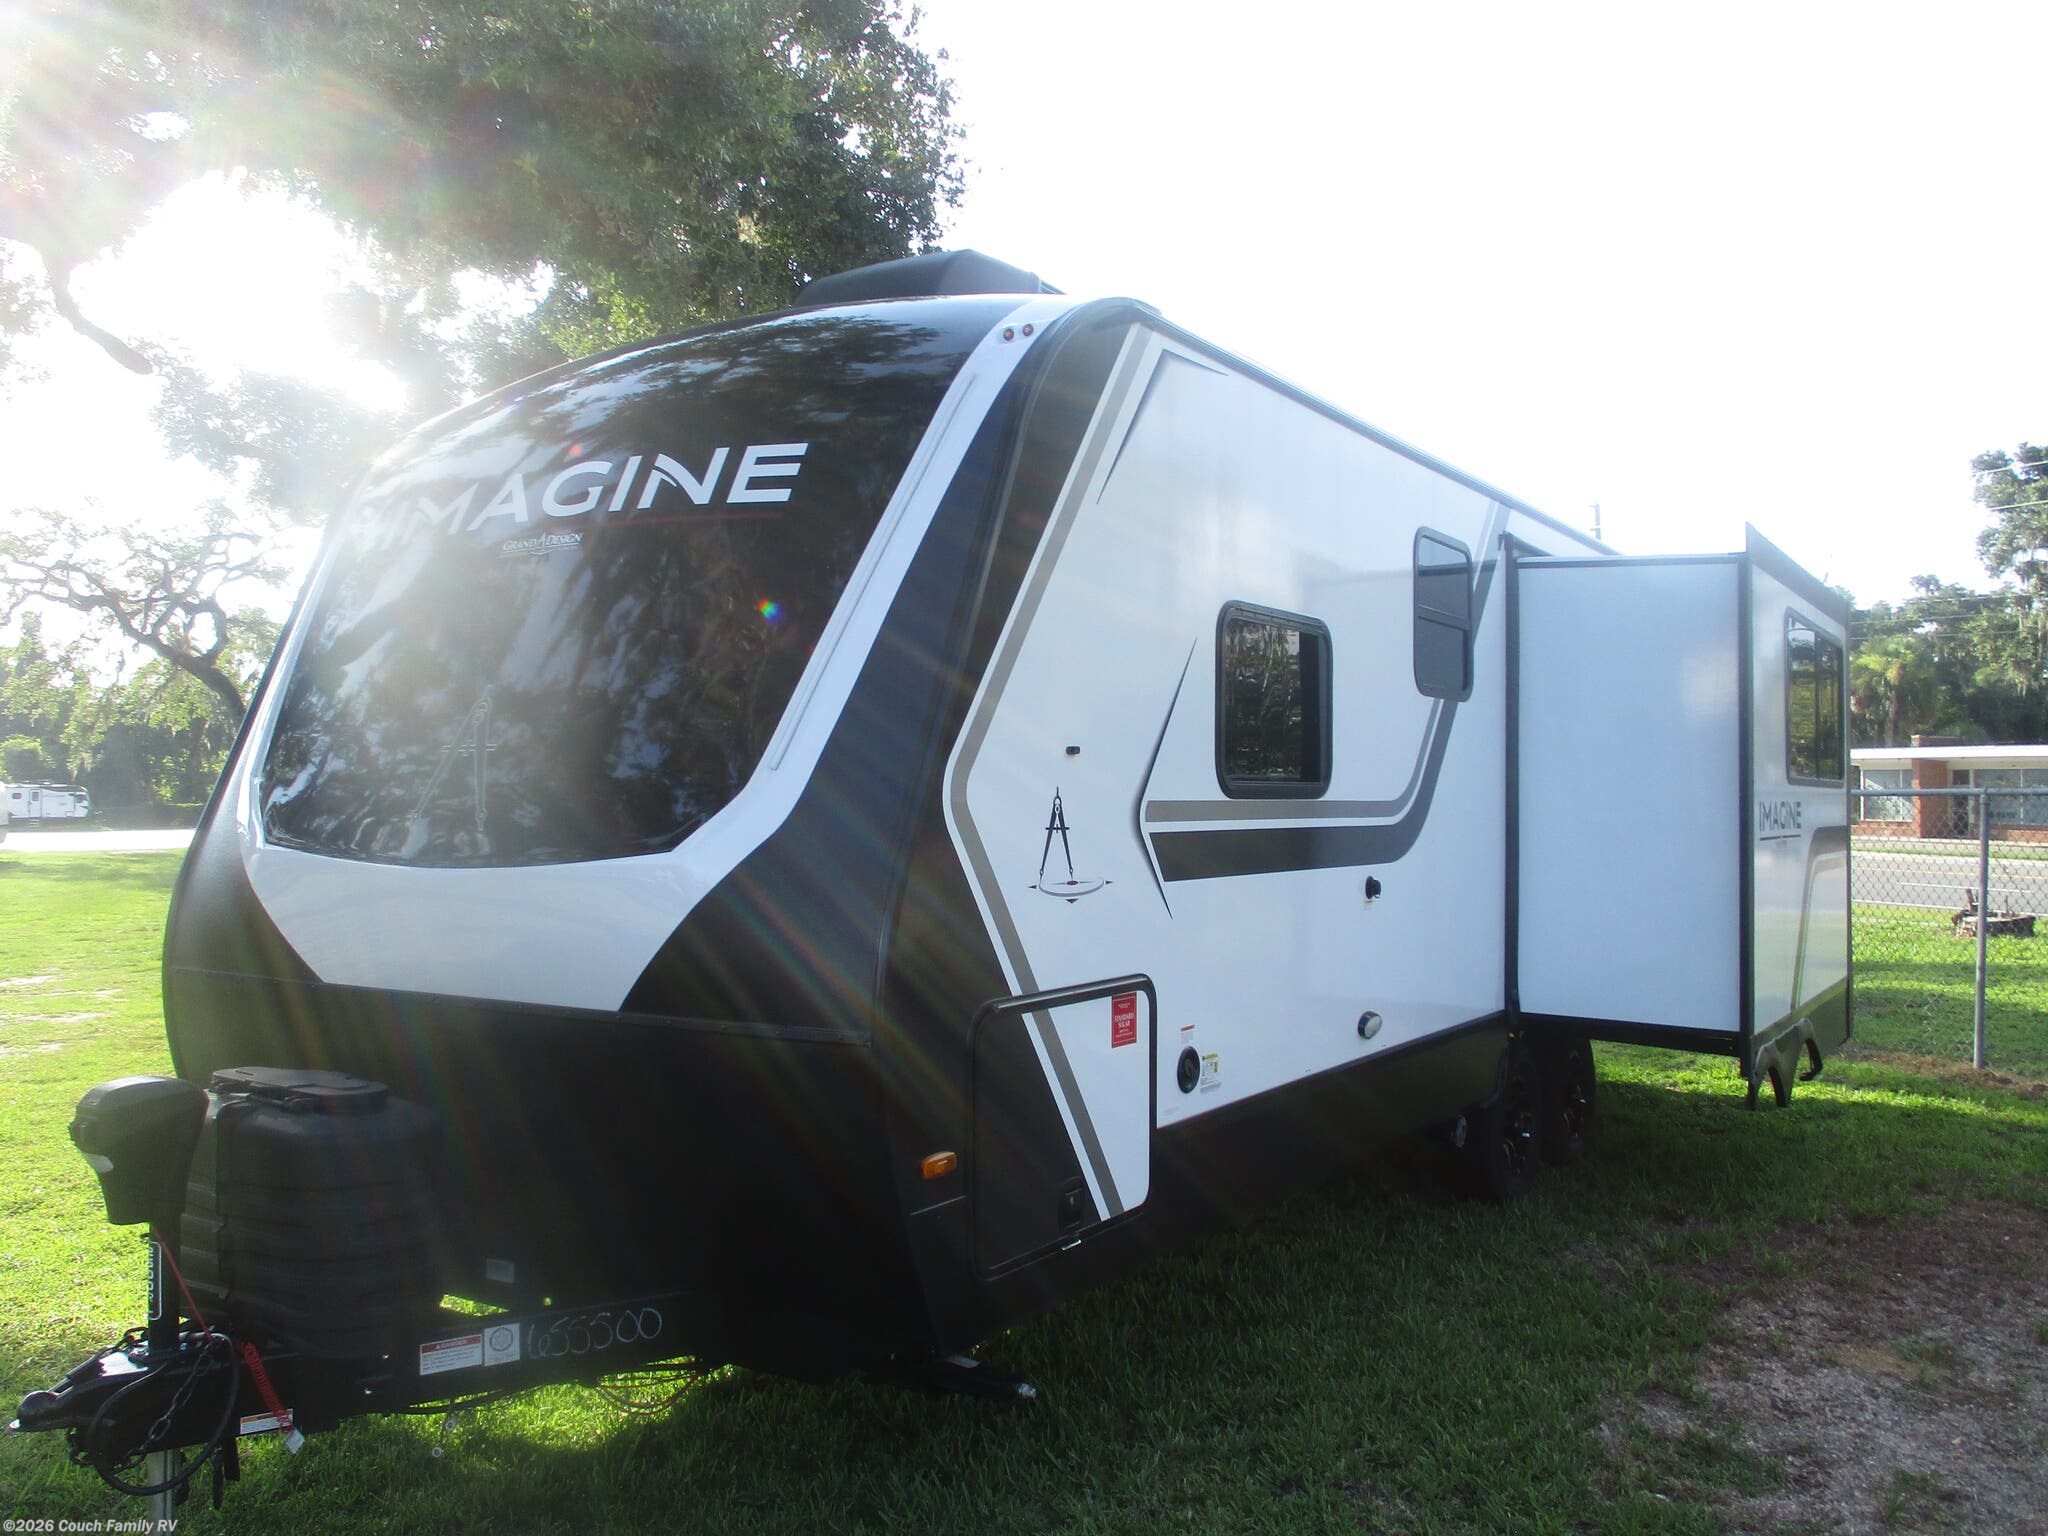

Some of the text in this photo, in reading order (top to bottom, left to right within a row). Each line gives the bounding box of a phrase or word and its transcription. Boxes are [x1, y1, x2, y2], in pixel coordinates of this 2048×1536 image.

[380, 443, 808, 551] IMAGINE
[503, 532, 584, 551] GRAND DESIGN
[1759, 800, 1802, 831] IMAGINE
